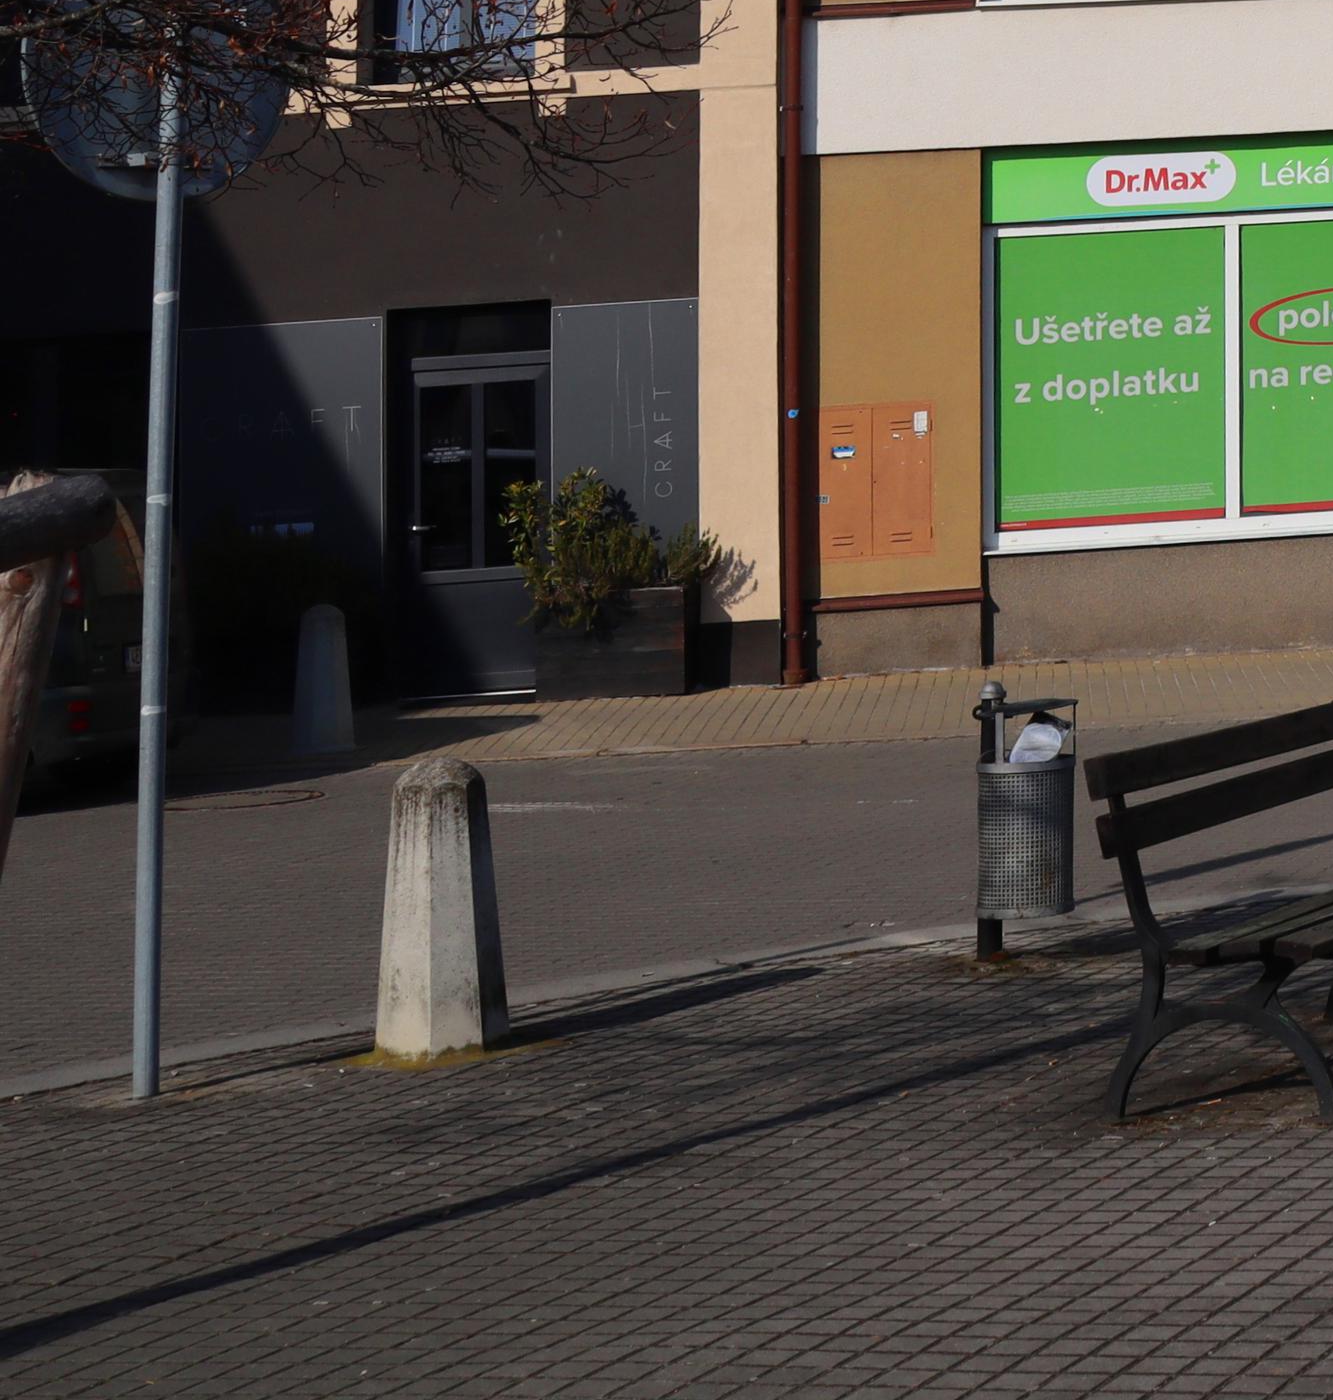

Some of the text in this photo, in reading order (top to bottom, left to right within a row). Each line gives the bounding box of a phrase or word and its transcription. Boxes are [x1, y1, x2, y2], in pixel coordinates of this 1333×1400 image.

[1105, 166, 1208, 194] Dr.Max
[1014, 306, 1212, 346] Ušetřete až
[1014, 367, 1199, 405] z doplatku
[1249, 366, 1289, 389] na
[653, 386, 673, 498] CRAFT
